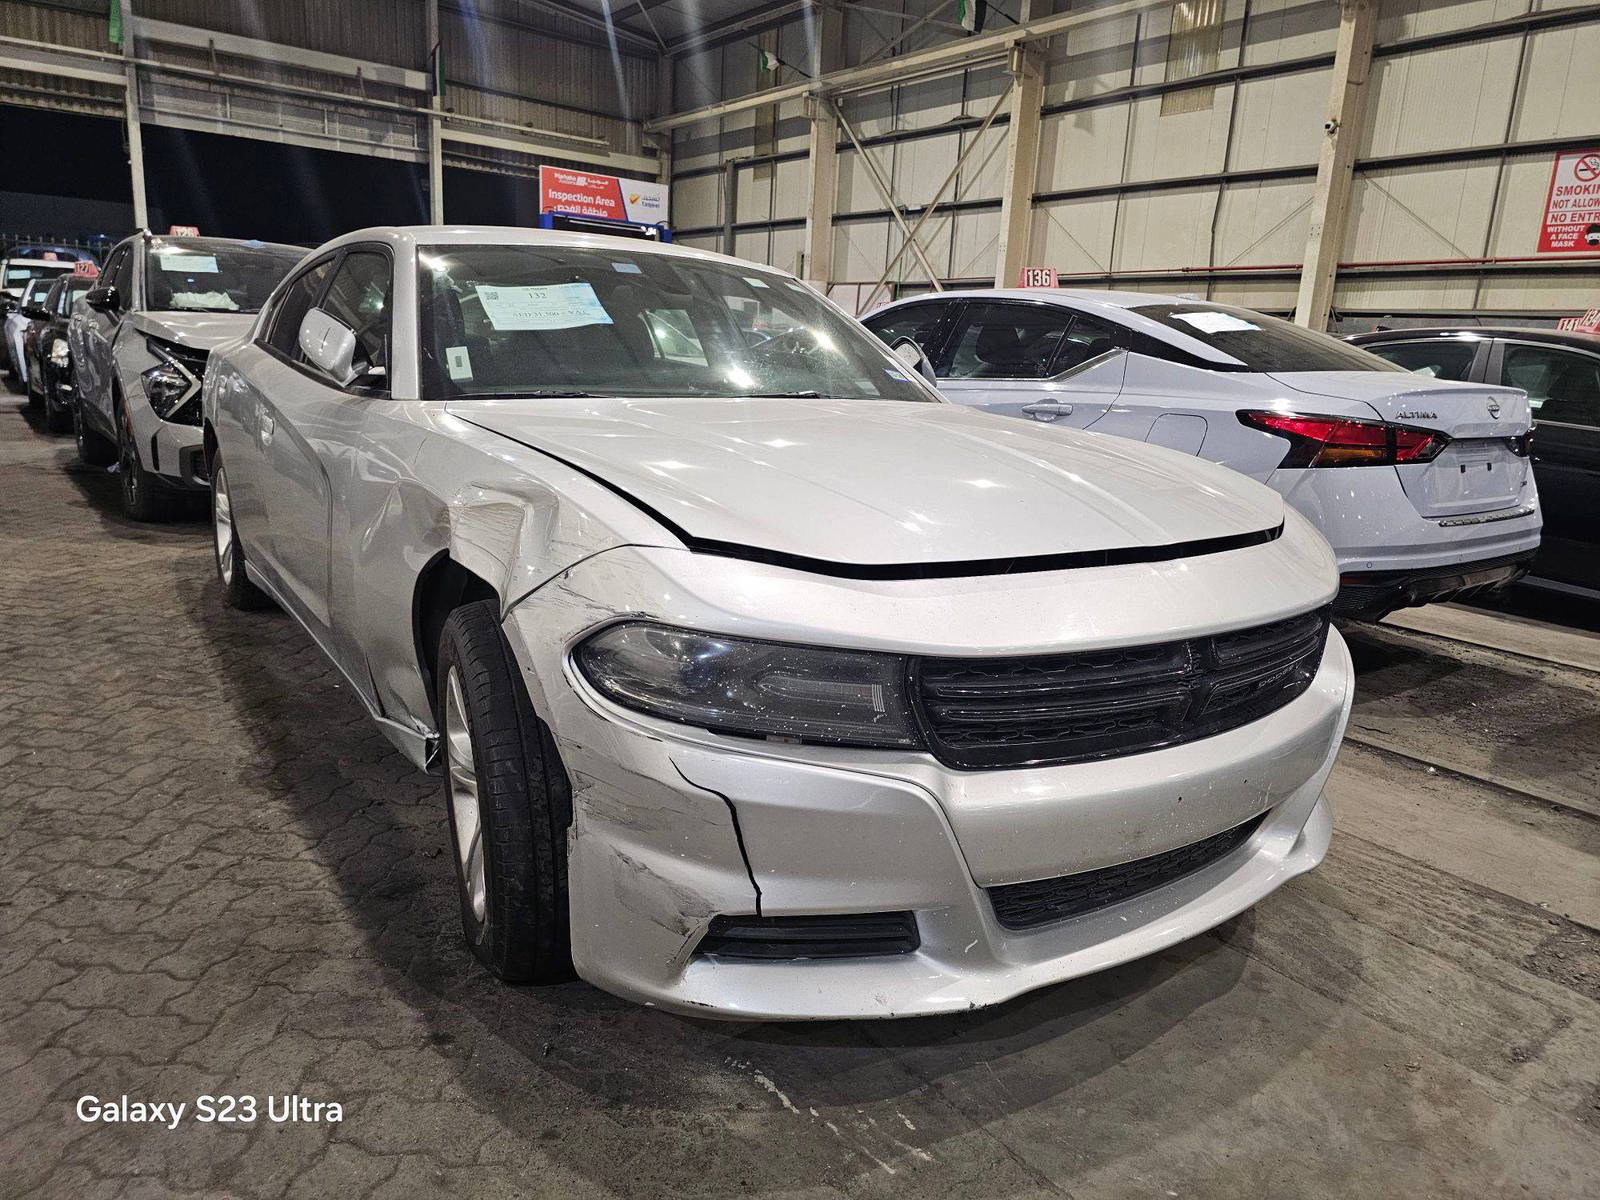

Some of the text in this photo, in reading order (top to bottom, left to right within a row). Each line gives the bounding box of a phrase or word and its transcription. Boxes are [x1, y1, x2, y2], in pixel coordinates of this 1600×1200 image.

[548, 189, 615, 207] Inspection Area
[1552, 199, 1570, 209] NOT
[1550, 213, 1567, 223] NO
[1547, 225, 1585, 233] WITHOUT
[1558, 232, 1579, 240] FACE
[1551, 240, 1575, 248] MASK
[1027, 269, 1051, 287] 136
[1395, 411, 1438, 419] ALTIMA
